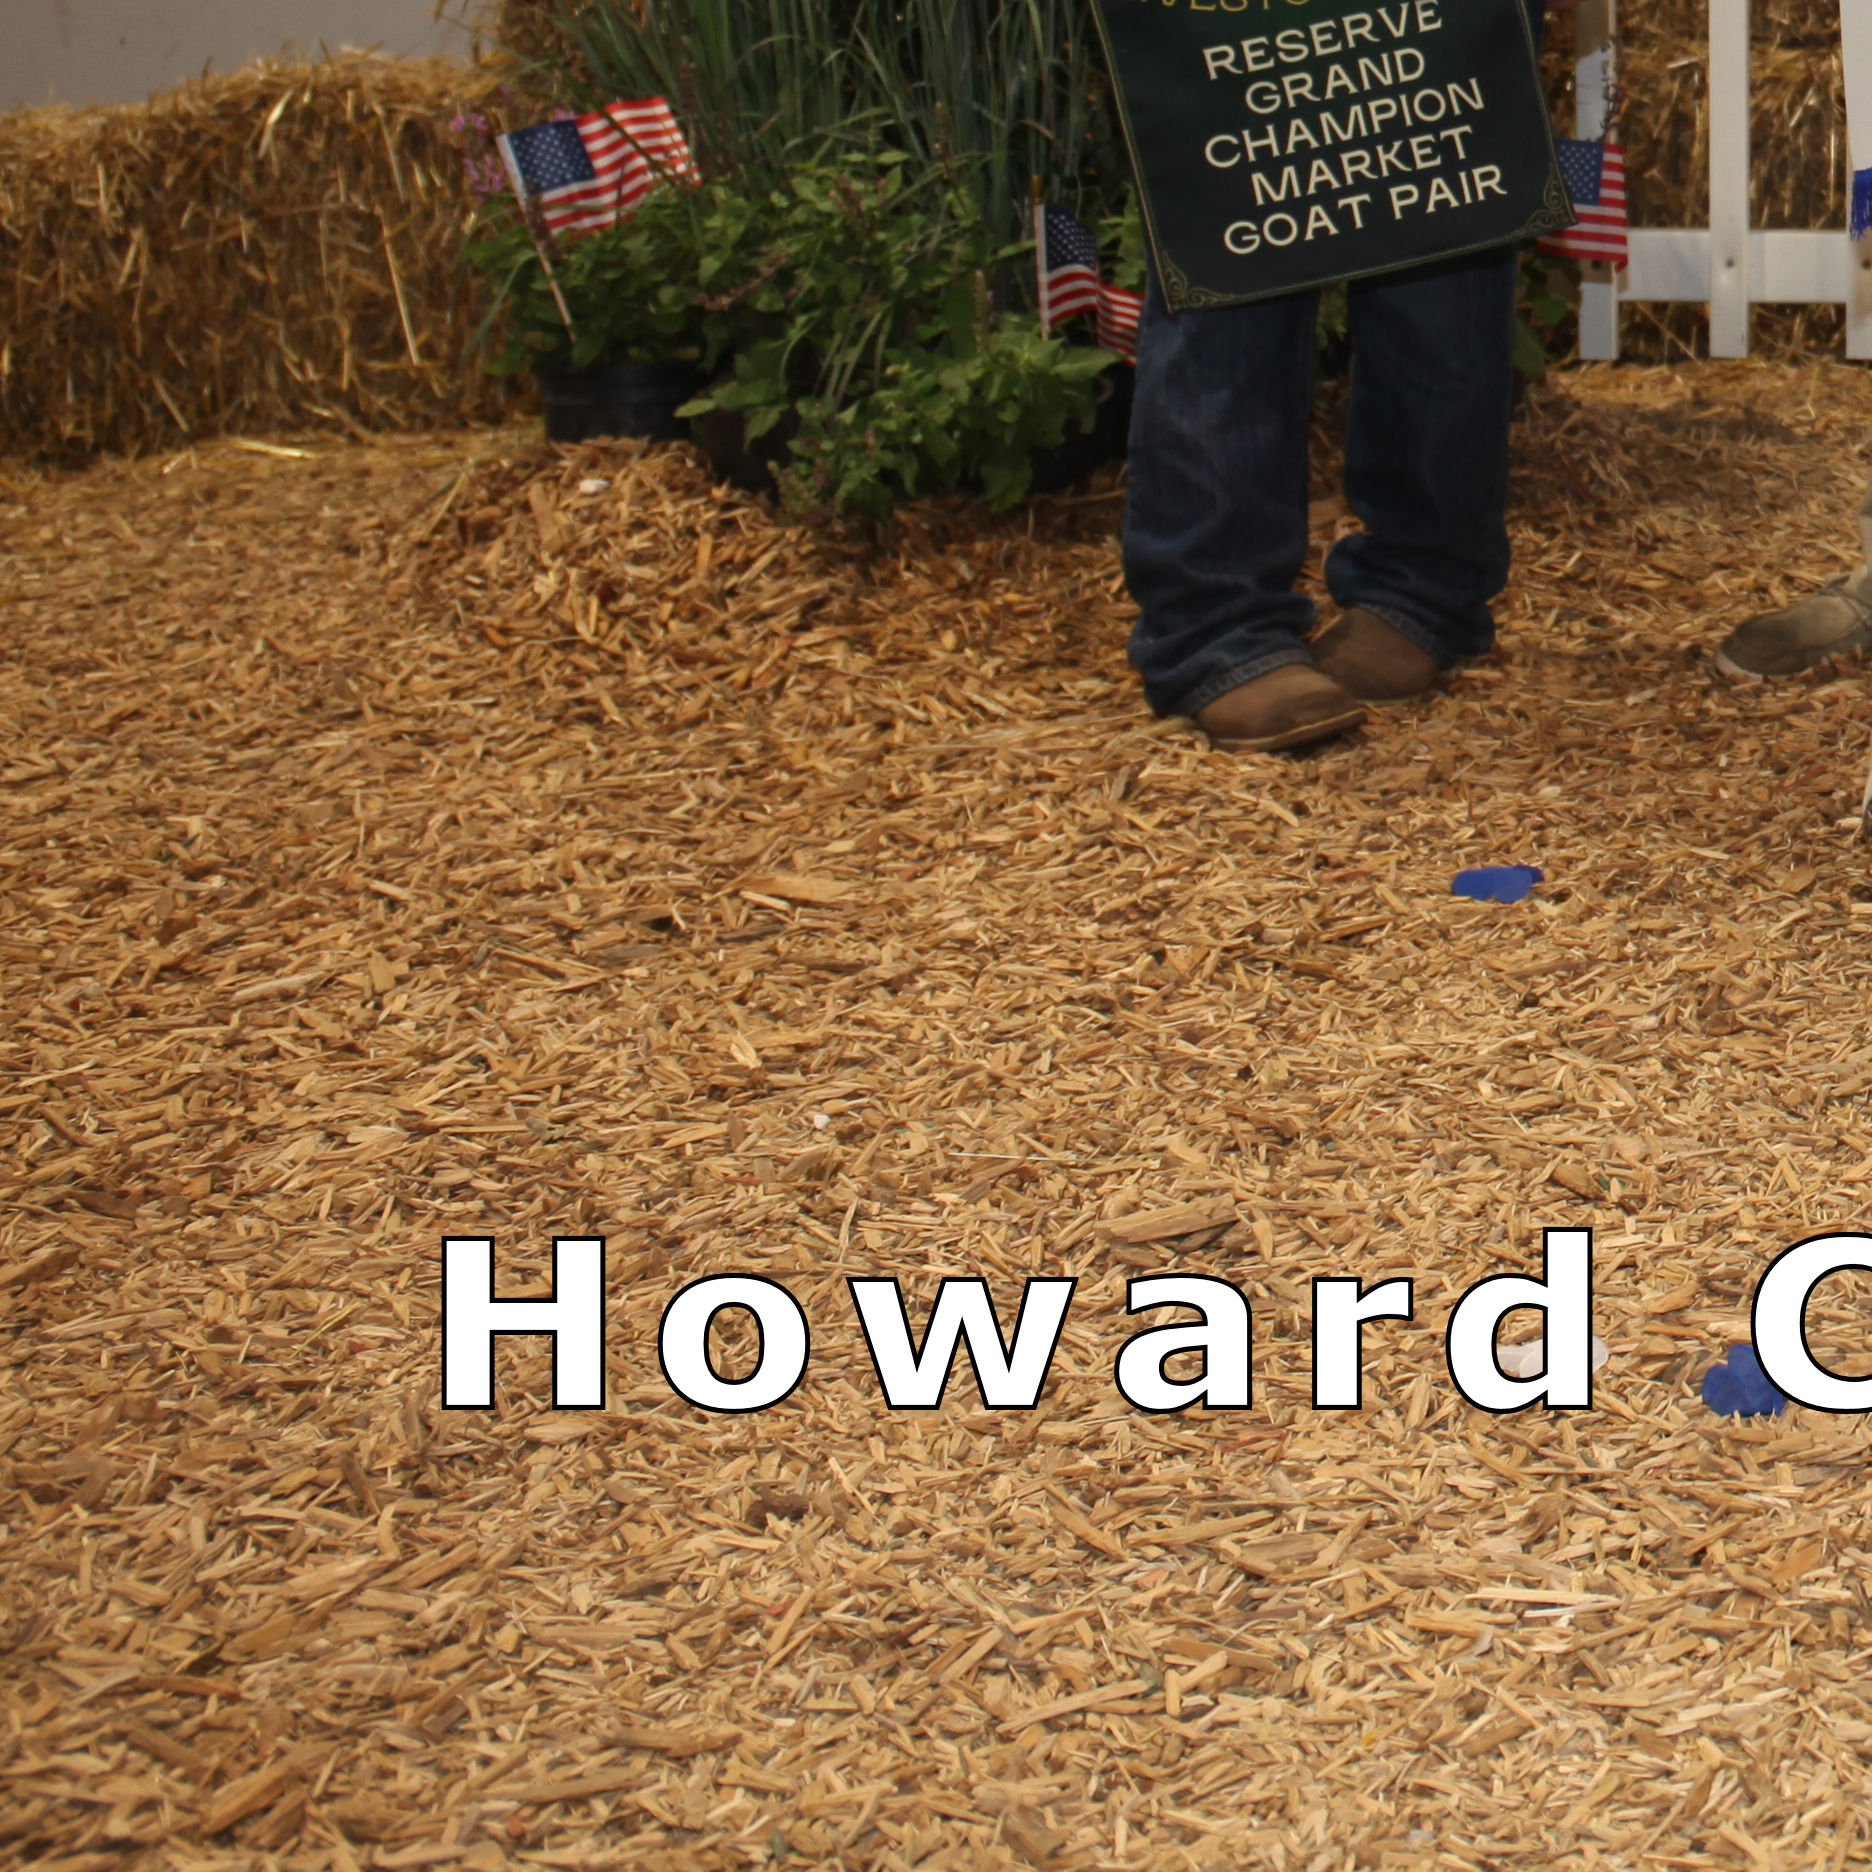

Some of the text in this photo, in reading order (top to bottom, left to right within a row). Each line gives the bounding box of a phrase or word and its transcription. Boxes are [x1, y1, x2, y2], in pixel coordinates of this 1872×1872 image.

[1204, 78, 1486, 168] CHAMPION
[1244, 47, 1426, 115] GRAND
[1250, 125, 1473, 206] MARKET
[1223, 164, 1508, 255] GOAT PAIR
